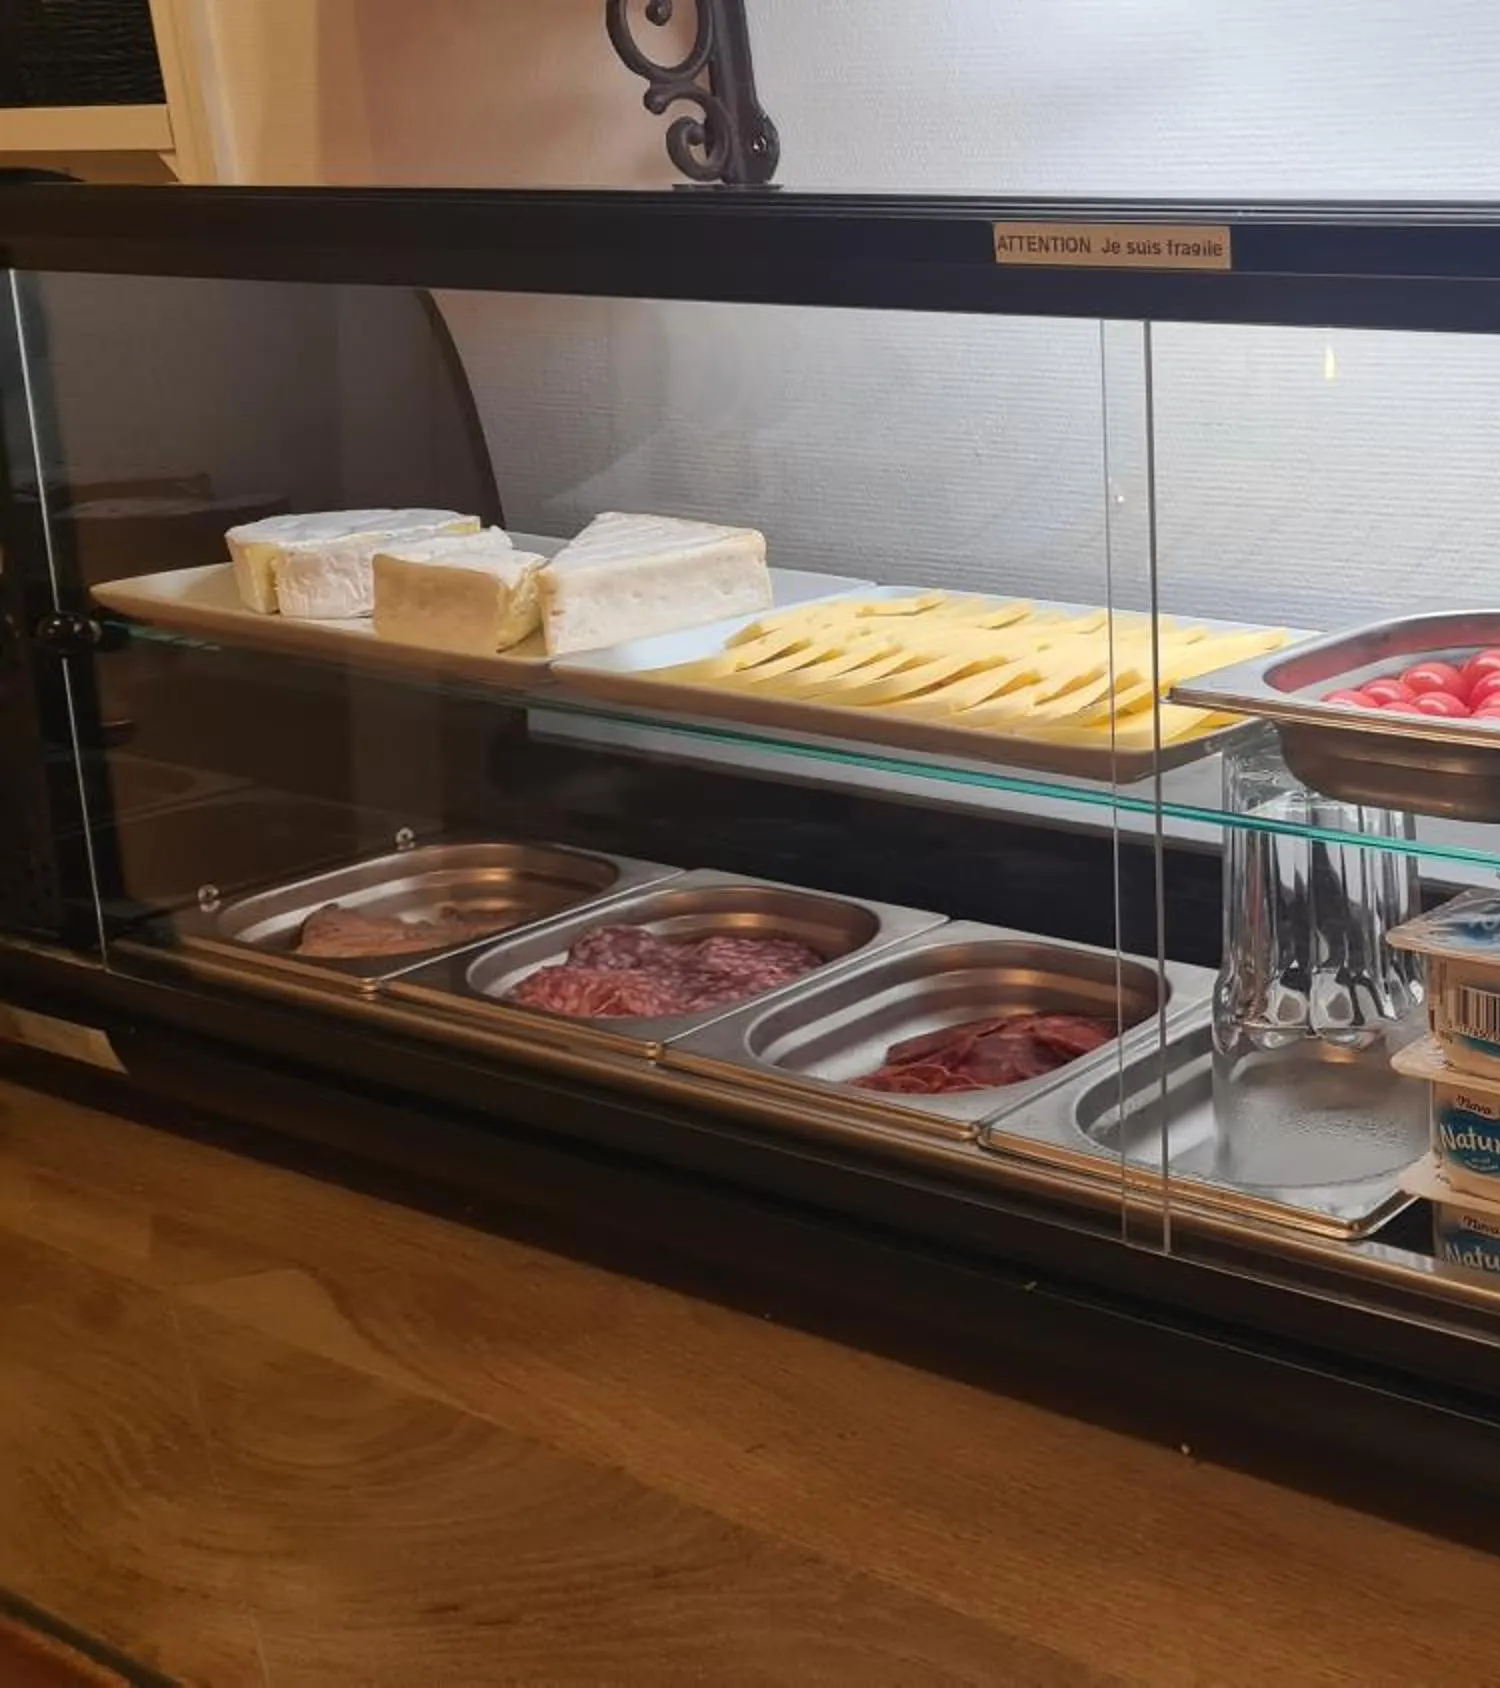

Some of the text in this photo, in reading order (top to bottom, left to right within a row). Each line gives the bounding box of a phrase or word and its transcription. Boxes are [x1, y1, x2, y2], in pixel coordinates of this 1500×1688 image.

[998, 235, 1091, 254] ATTENTION
[1102, 239, 1120, 255] Je
[1127, 240, 1161, 256] suis
